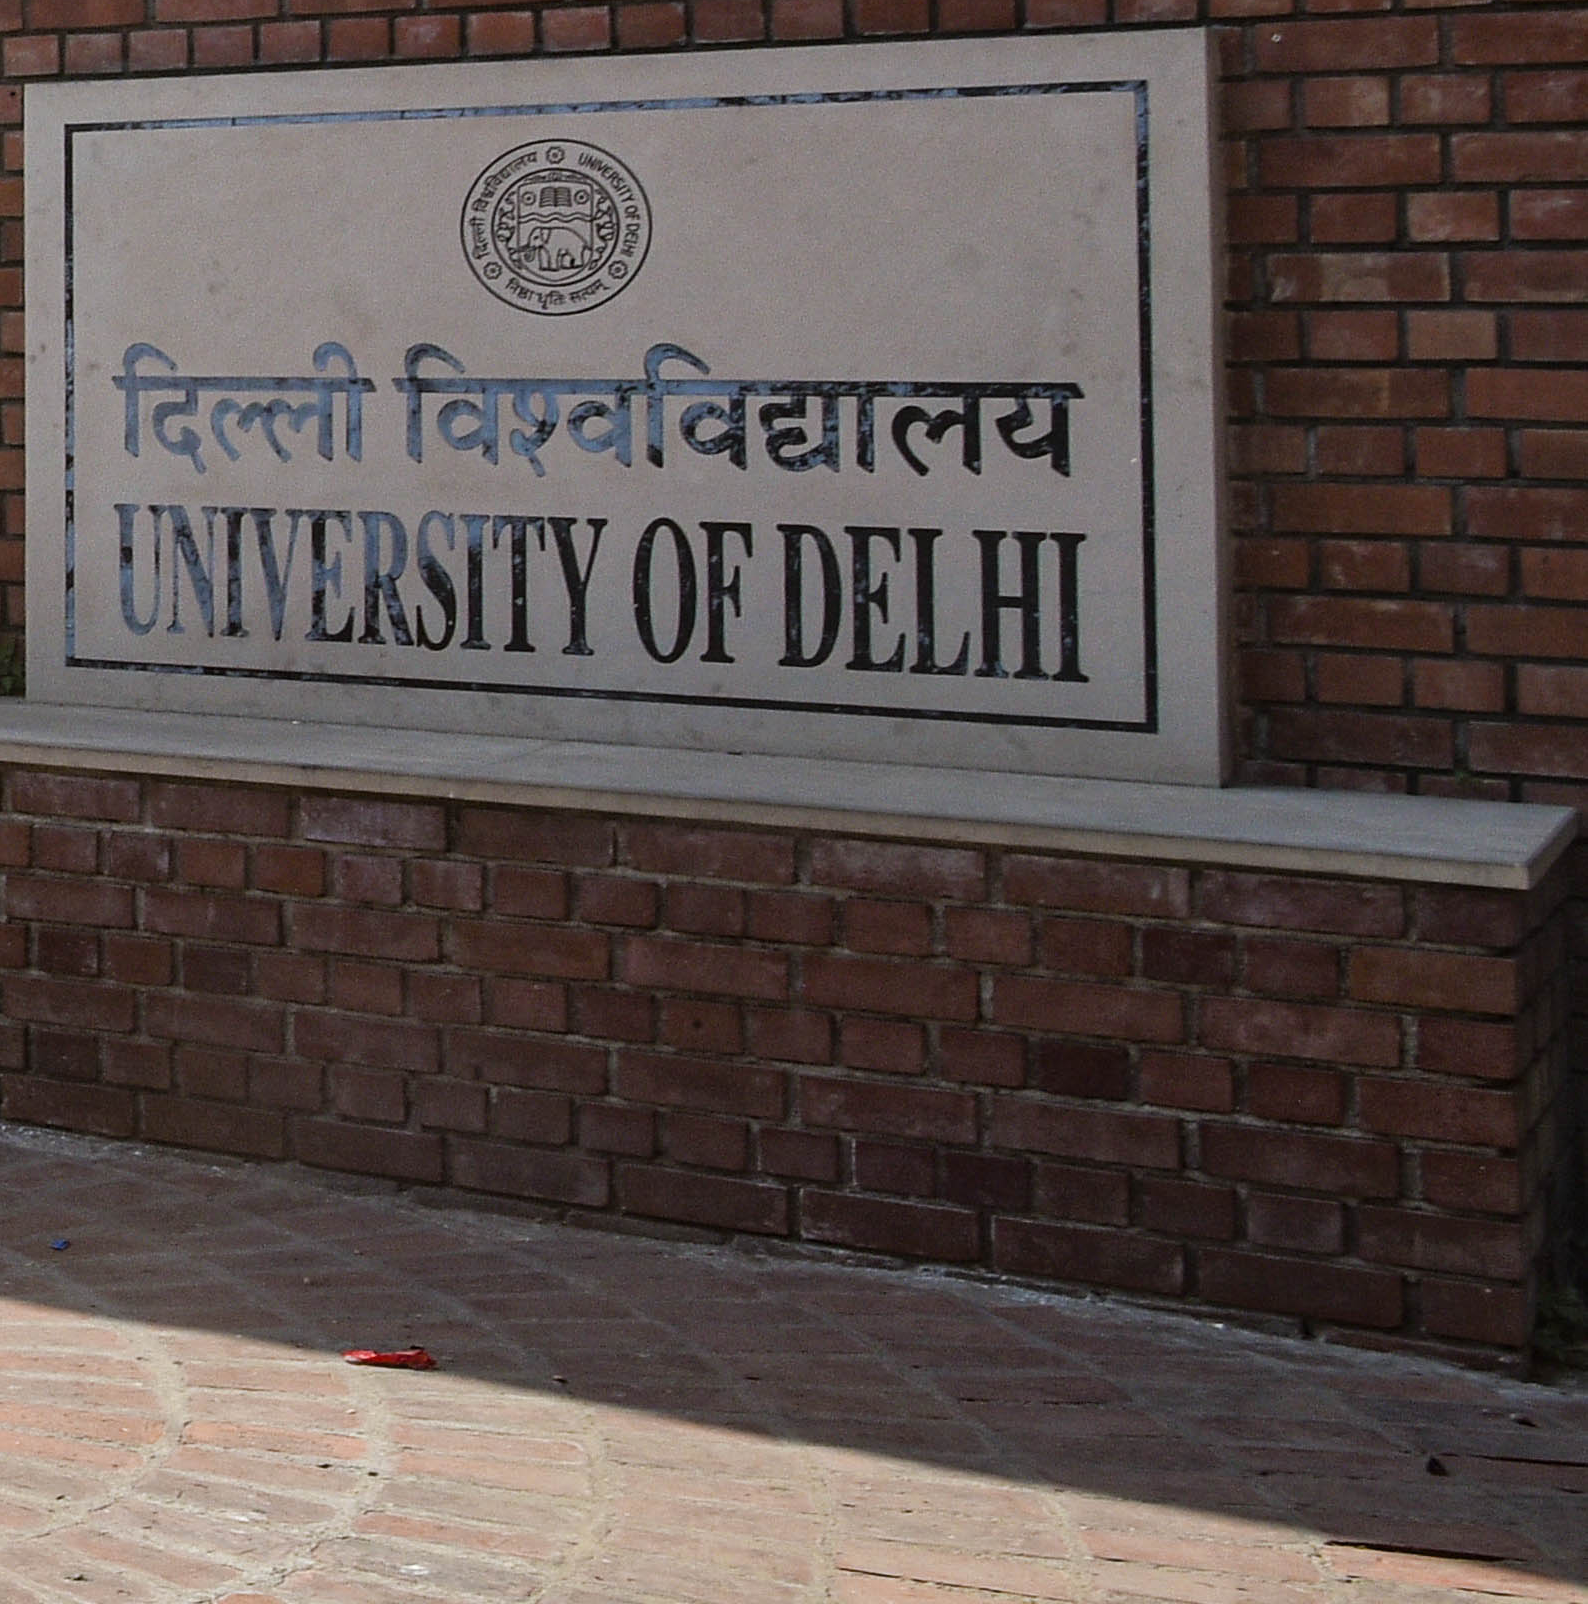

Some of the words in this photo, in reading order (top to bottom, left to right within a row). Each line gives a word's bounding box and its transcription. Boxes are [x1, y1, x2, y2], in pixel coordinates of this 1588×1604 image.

[577, 151, 635, 204] UNIVERSITY
[624, 204, 641, 222] OF
[622, 222, 642, 258] DELHI
[113, 341, 376, 474] दिल्ली
[393, 341, 1088, 477] विश्वविद्यालय
[114, 503, 608, 657] UNIVERSITY
[633, 516, 753, 665] OF
[777, 522, 1089, 684] DELHI
